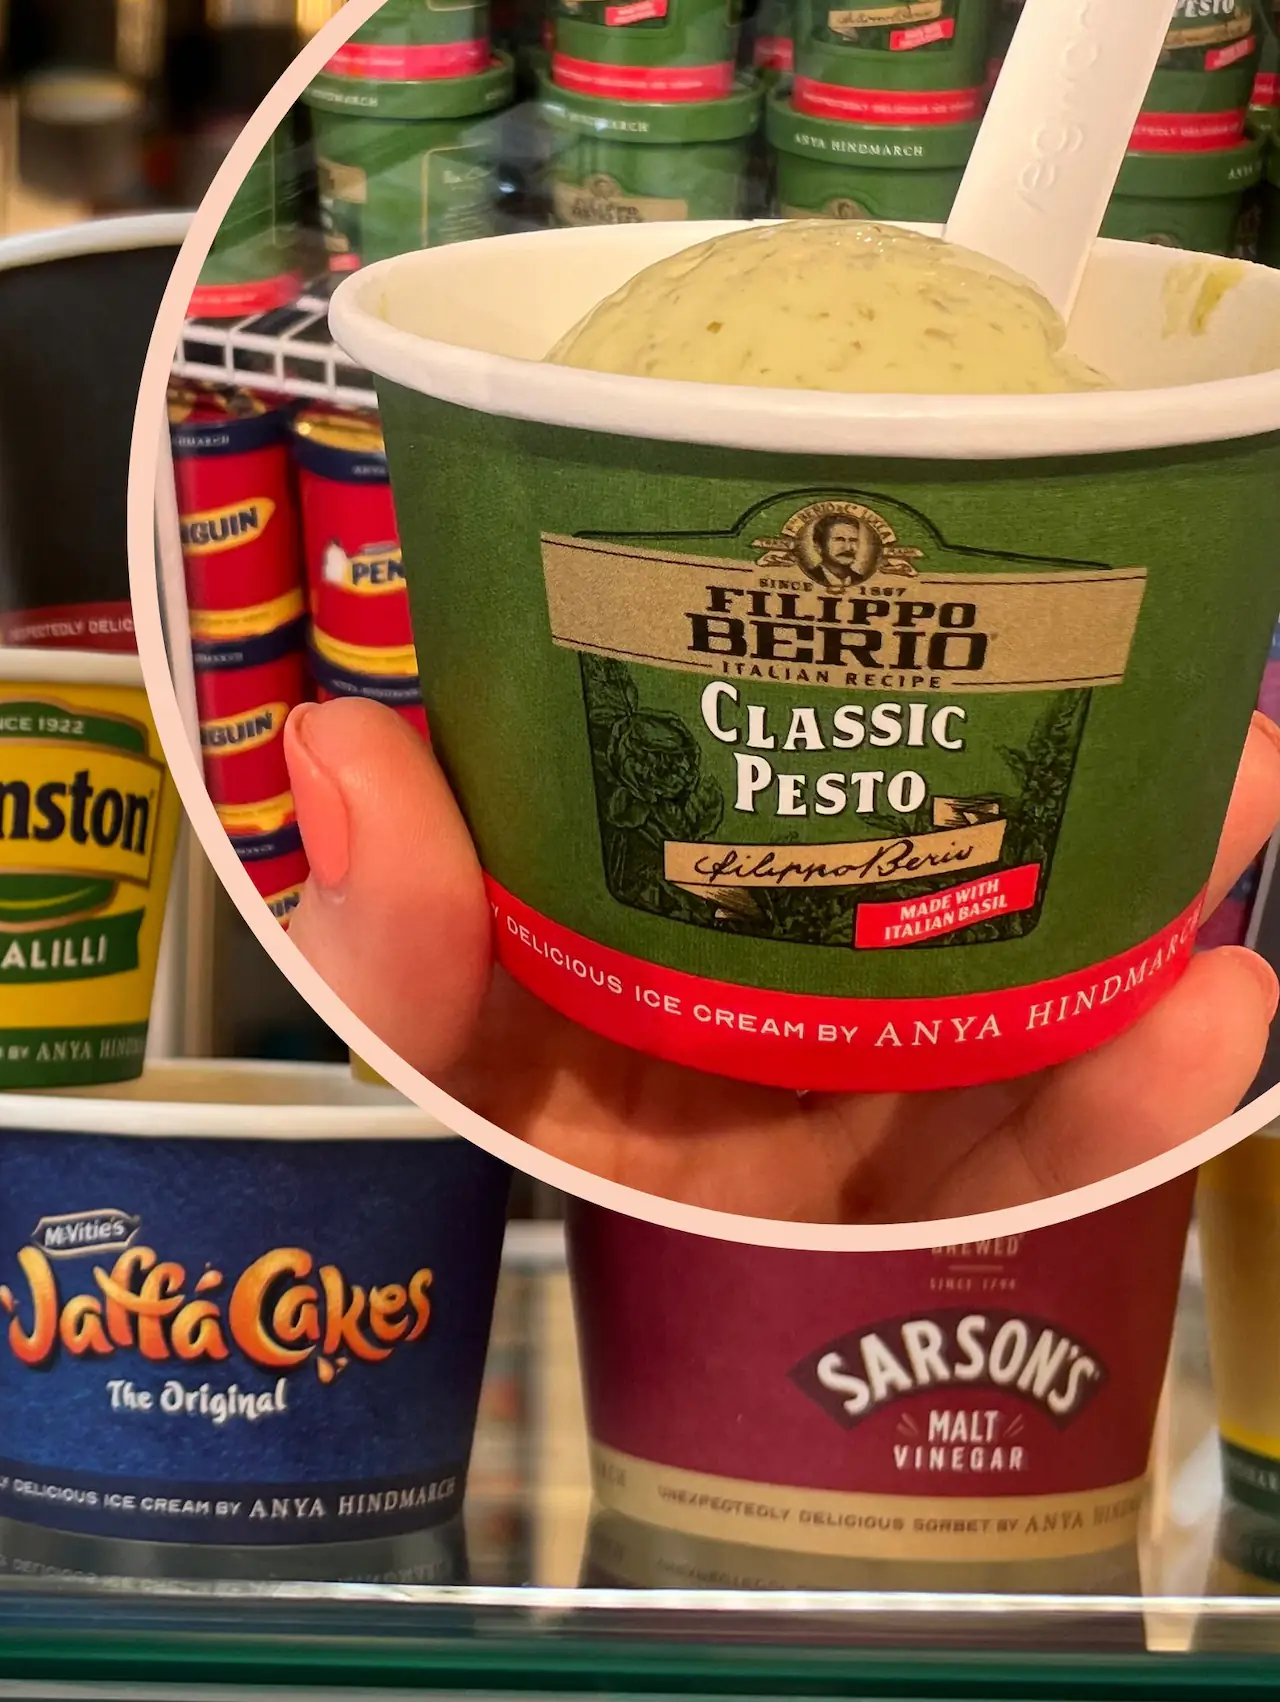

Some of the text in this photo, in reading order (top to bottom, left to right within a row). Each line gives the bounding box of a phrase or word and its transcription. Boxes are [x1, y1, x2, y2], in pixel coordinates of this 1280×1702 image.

[831, 139, 924, 157] HINDMARCH
[704, 585, 976, 629] FILIPPO
[759, 578, 814, 592] SINCE
[684, 612, 989, 671] BERIO
[722, 660, 943, 689] ITALIAN RECIPE
[39, 715, 86, 735] 1922
[700, 680, 968, 751] CLASSIC
[732, 752, 927, 817] PESTO
[883, 894, 1009, 941] ITALIAN BASIL
[900, 878, 1000, 922] MADE WITH
[505, 914, 625, 995] DELICIOUS
[634, 984, 683, 1017] ICE
[692, 1003, 805, 1041] CREAM
[817, 1024, 860, 1045] BY
[873, 1012, 1003, 1048] ANYA
[7, 1045, 31, 1061] BY
[35, 1038, 93, 1062] ANYA
[6, 1246, 435, 1370] Jaffa Cakes
[816, 1313, 1094, 1417] SARSON'S
[105, 1377, 289, 1424] The Original
[927, 1409, 999, 1443] MALT
[892, 1444, 1025, 1472] VINEGAR
[13, 1477, 98, 1506] DELICIOUS
[103, 1493, 137, 1509] ICE
[139, 1496, 211, 1515] CREAM
[214, 1500, 242, 1515] BY
[248, 1497, 327, 1520] ANYA
[337, 1476, 458, 1518] HINDMARCH
[657, 1484, 792, 1522] UNEXPECTEDLY
[798, 1508, 905, 1532] DELICIOUS
[911, 1517, 991, 1534] SORBET
[996, 1517, 1020, 1533] BY
[1023, 1510, 1085, 1536] ANYA
